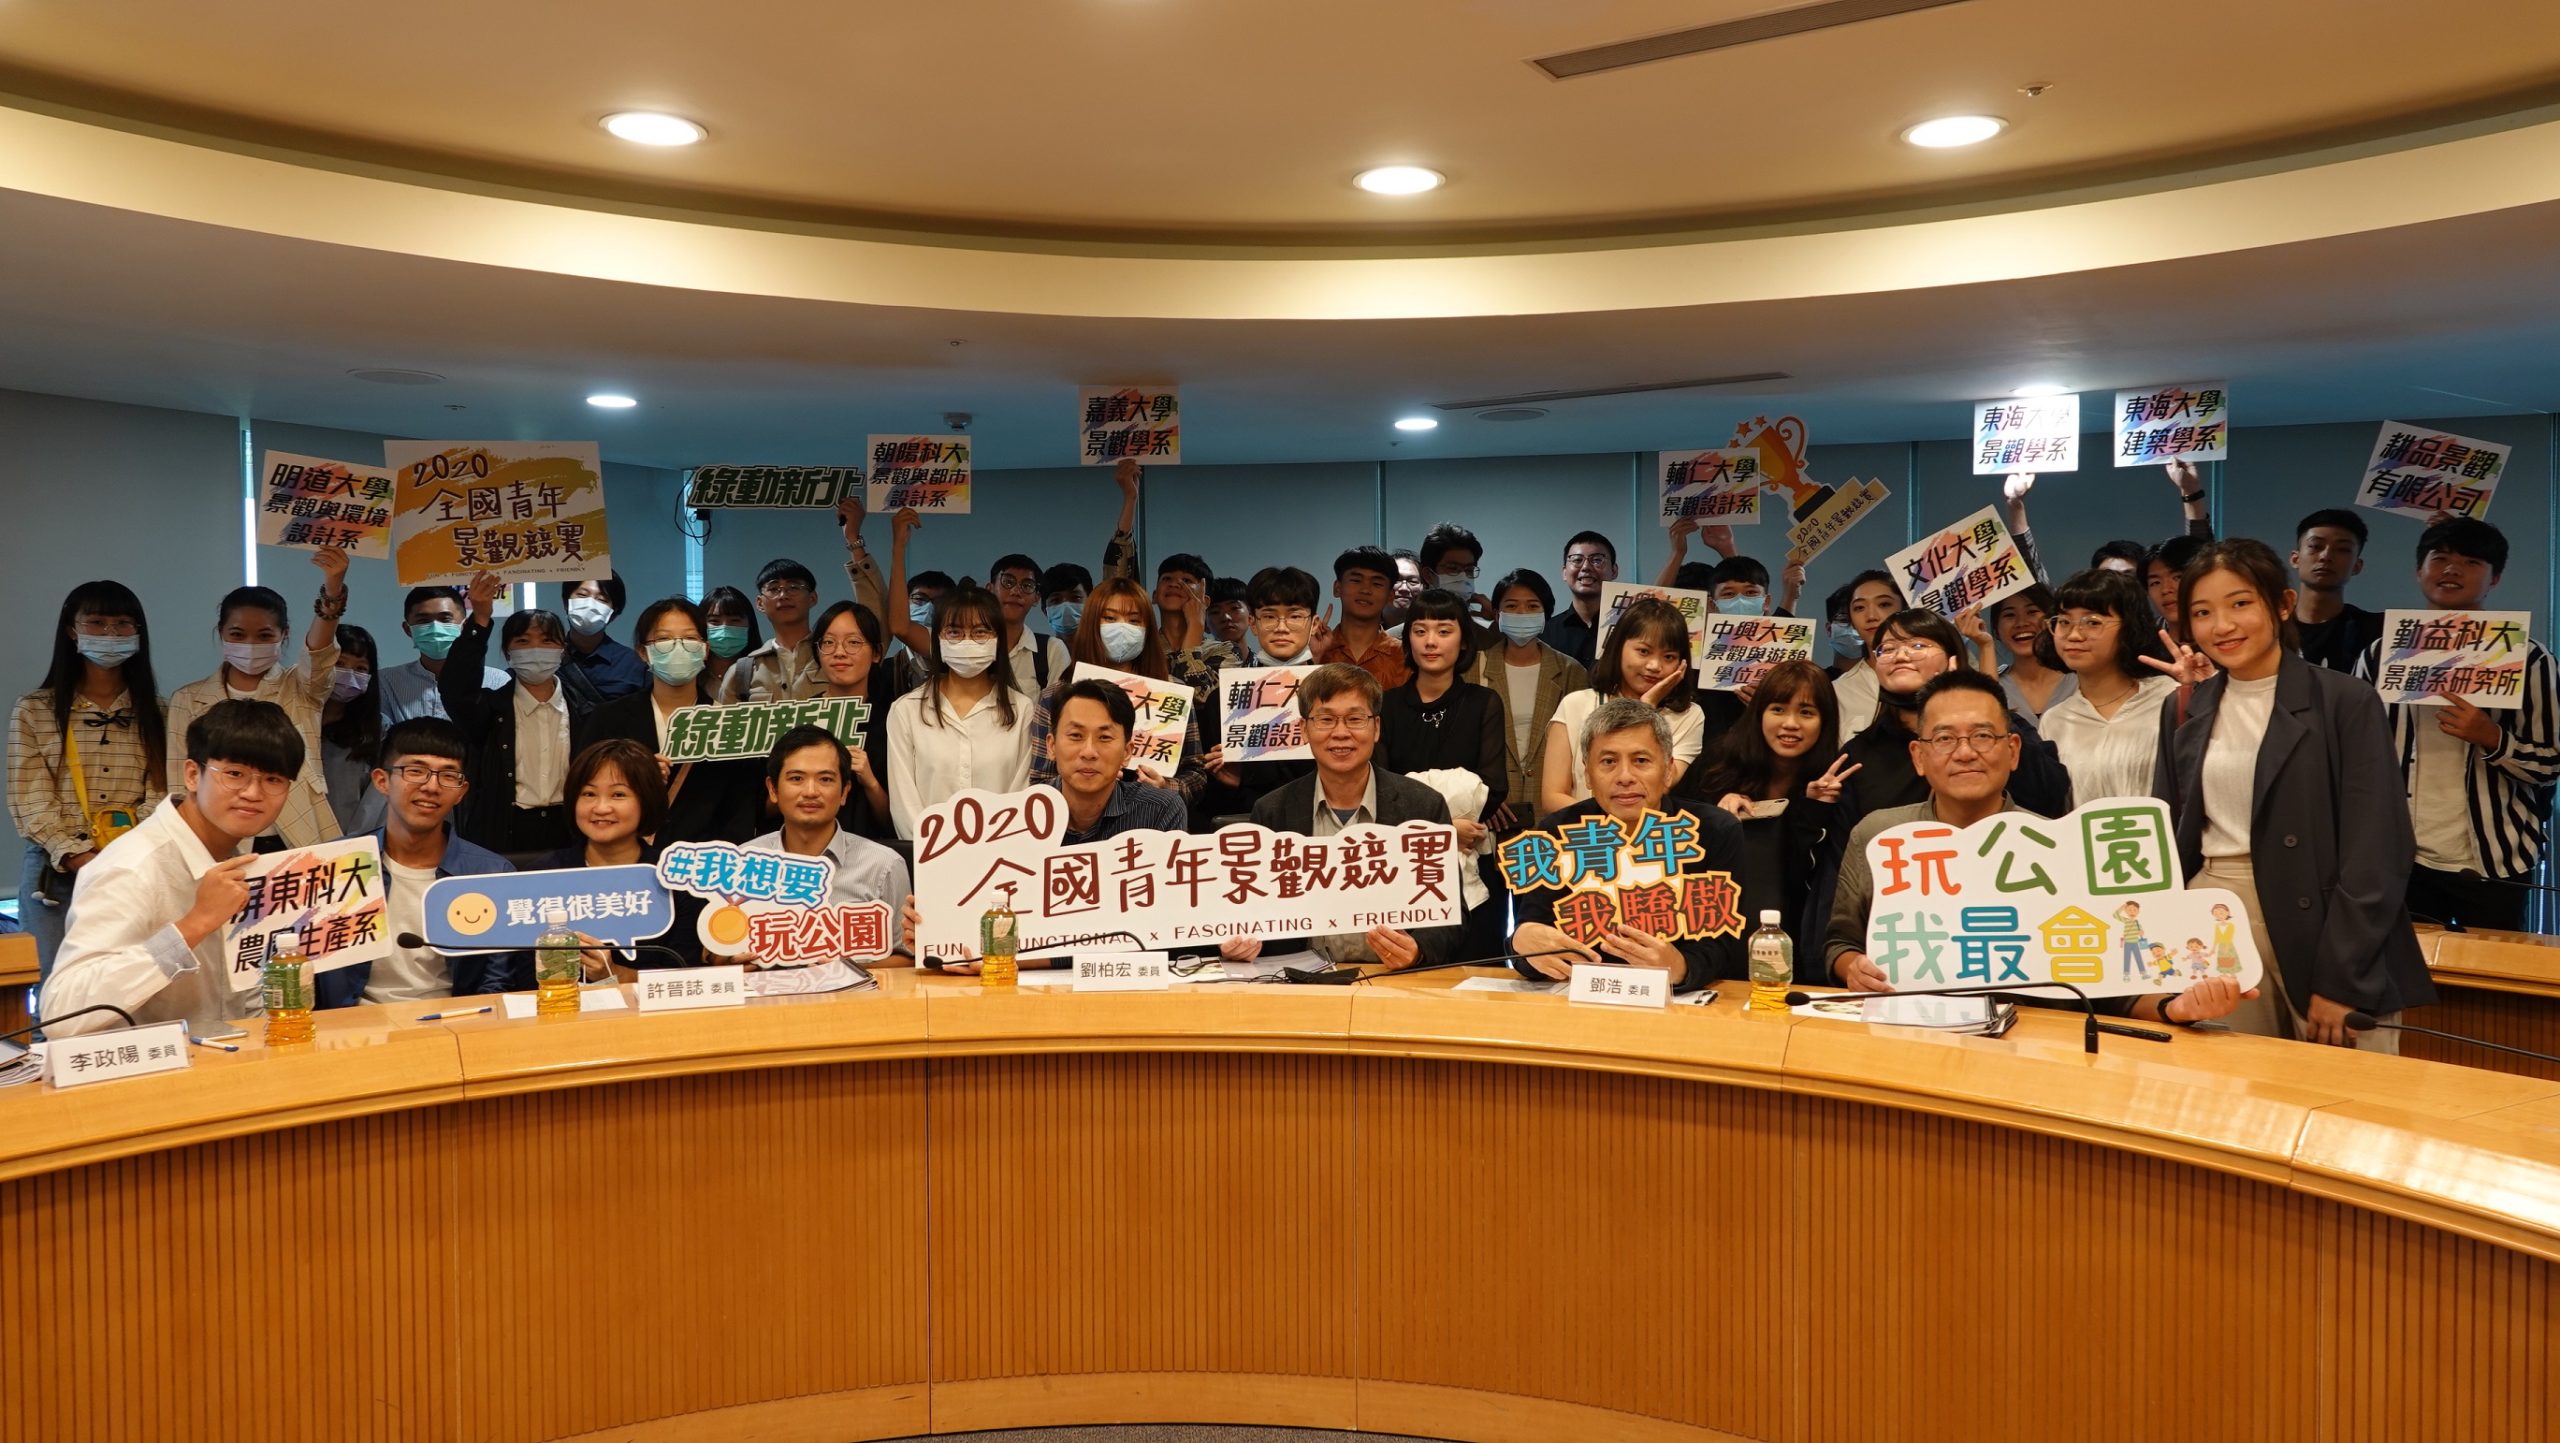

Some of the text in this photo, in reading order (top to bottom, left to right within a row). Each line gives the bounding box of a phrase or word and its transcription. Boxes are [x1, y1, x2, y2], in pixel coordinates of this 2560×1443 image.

[1085, 395, 1172, 422] 嘉義大學
[1981, 404, 2070, 432] 東海大學
[2122, 390, 2220, 422] 東海大學
[873, 442, 966, 463] 朝陽科大
[1085, 430, 1172, 456] 景觀學系
[1979, 436, 2070, 465] 景觀學系
[2121, 424, 2220, 457] 建築學系
[269, 463, 392, 501] 明道大學
[413, 453, 488, 487] 2020
[690, 467, 862, 506] 綠動新北
[871, 468, 968, 485] 景觀與都市
[1665, 458, 1755, 484] 輔仁大學
[419, 480, 567, 522] 全國青年
[889, 490, 949, 507] 設計系
[1662, 494, 1757, 516] 景觀設計系
[2366, 469, 2483, 516] 有限公司
[264, 493, 389, 527] 景觀與環境
[285, 523, 362, 549] 設計系
[453, 521, 585, 566] 景觀競賽
[1903, 520, 1999, 591] 文化大學
[1921, 552, 2019, 616] 景觀學系
[1711, 620, 1808, 644] 中興大學
[2390, 619, 2520, 652] 勤益科大
[1227, 679, 1301, 710] 輔仁大
[2381, 665, 2522, 696] 景觀系研究所
[1121, 688, 1186, 724] 大學
[919, 793, 1055, 864] 2020
[1503, 814, 1701, 887] 我青年
[1877, 805, 2172, 898] 玩公園
[667, 850, 825, 904] #我想要
[957, 825, 1452, 918] 全國青年景觀競賽
[229, 857, 372, 924] 屏東科大
[506, 889, 653, 926] 覺得很美好
[1558, 872, 1742, 942] 我驕傲
[752, 909, 884, 958] 玩公園
[924, 943, 963, 957] FUN
[1018, 931, 1133, 950] UNCTIONAL
[1174, 917, 1313, 939] FASCINATING
[1353, 907, 1453, 927] FRIENDLY
[1872, 905, 2111, 984] 我最會
[1080, 962, 1161, 978] 劉柏宏 委員
[1589, 977, 1650, 997] 鄧浩 委員
[647, 980, 735, 999] 許晉誌 委員
[69, 1044, 178, 1073] 李政陽 委員
